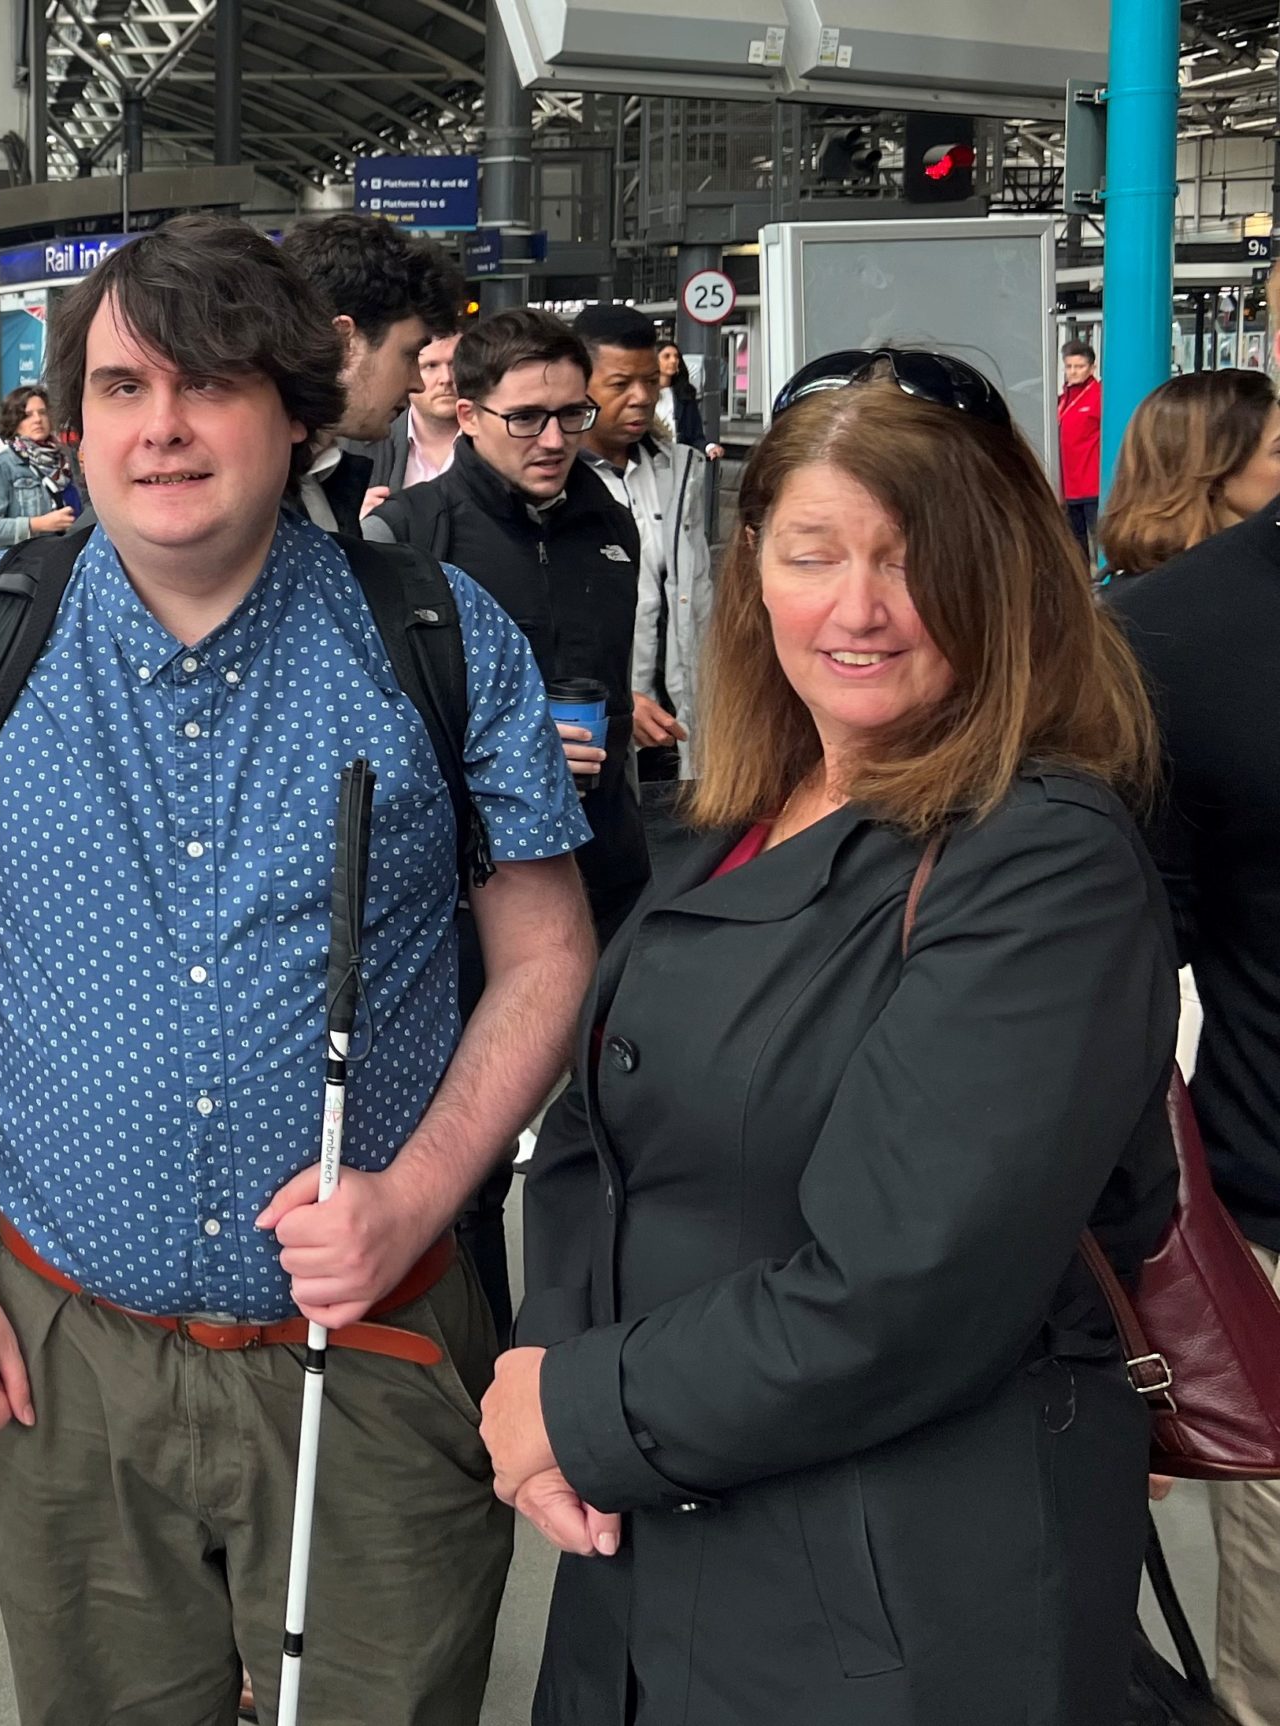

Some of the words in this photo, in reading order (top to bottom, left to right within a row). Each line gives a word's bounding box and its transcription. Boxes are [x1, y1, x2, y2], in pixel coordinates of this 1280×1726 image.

[383, 178, 420, 189] Platforms
[442, 179, 456, 189] and
[457, 178, 469, 189] 8d
[382, 199, 420, 209] Platforms
[421, 200, 427, 209] 0
[429, 199, 438, 209] to
[439, 199, 446, 209] 6
[401, 213, 415, 222] out
[1248, 239, 1268, 256] 9b
[45, 244, 74, 273] Rail
[695, 283, 725, 309] 25
[324, 1128, 335, 1185] ambutech
